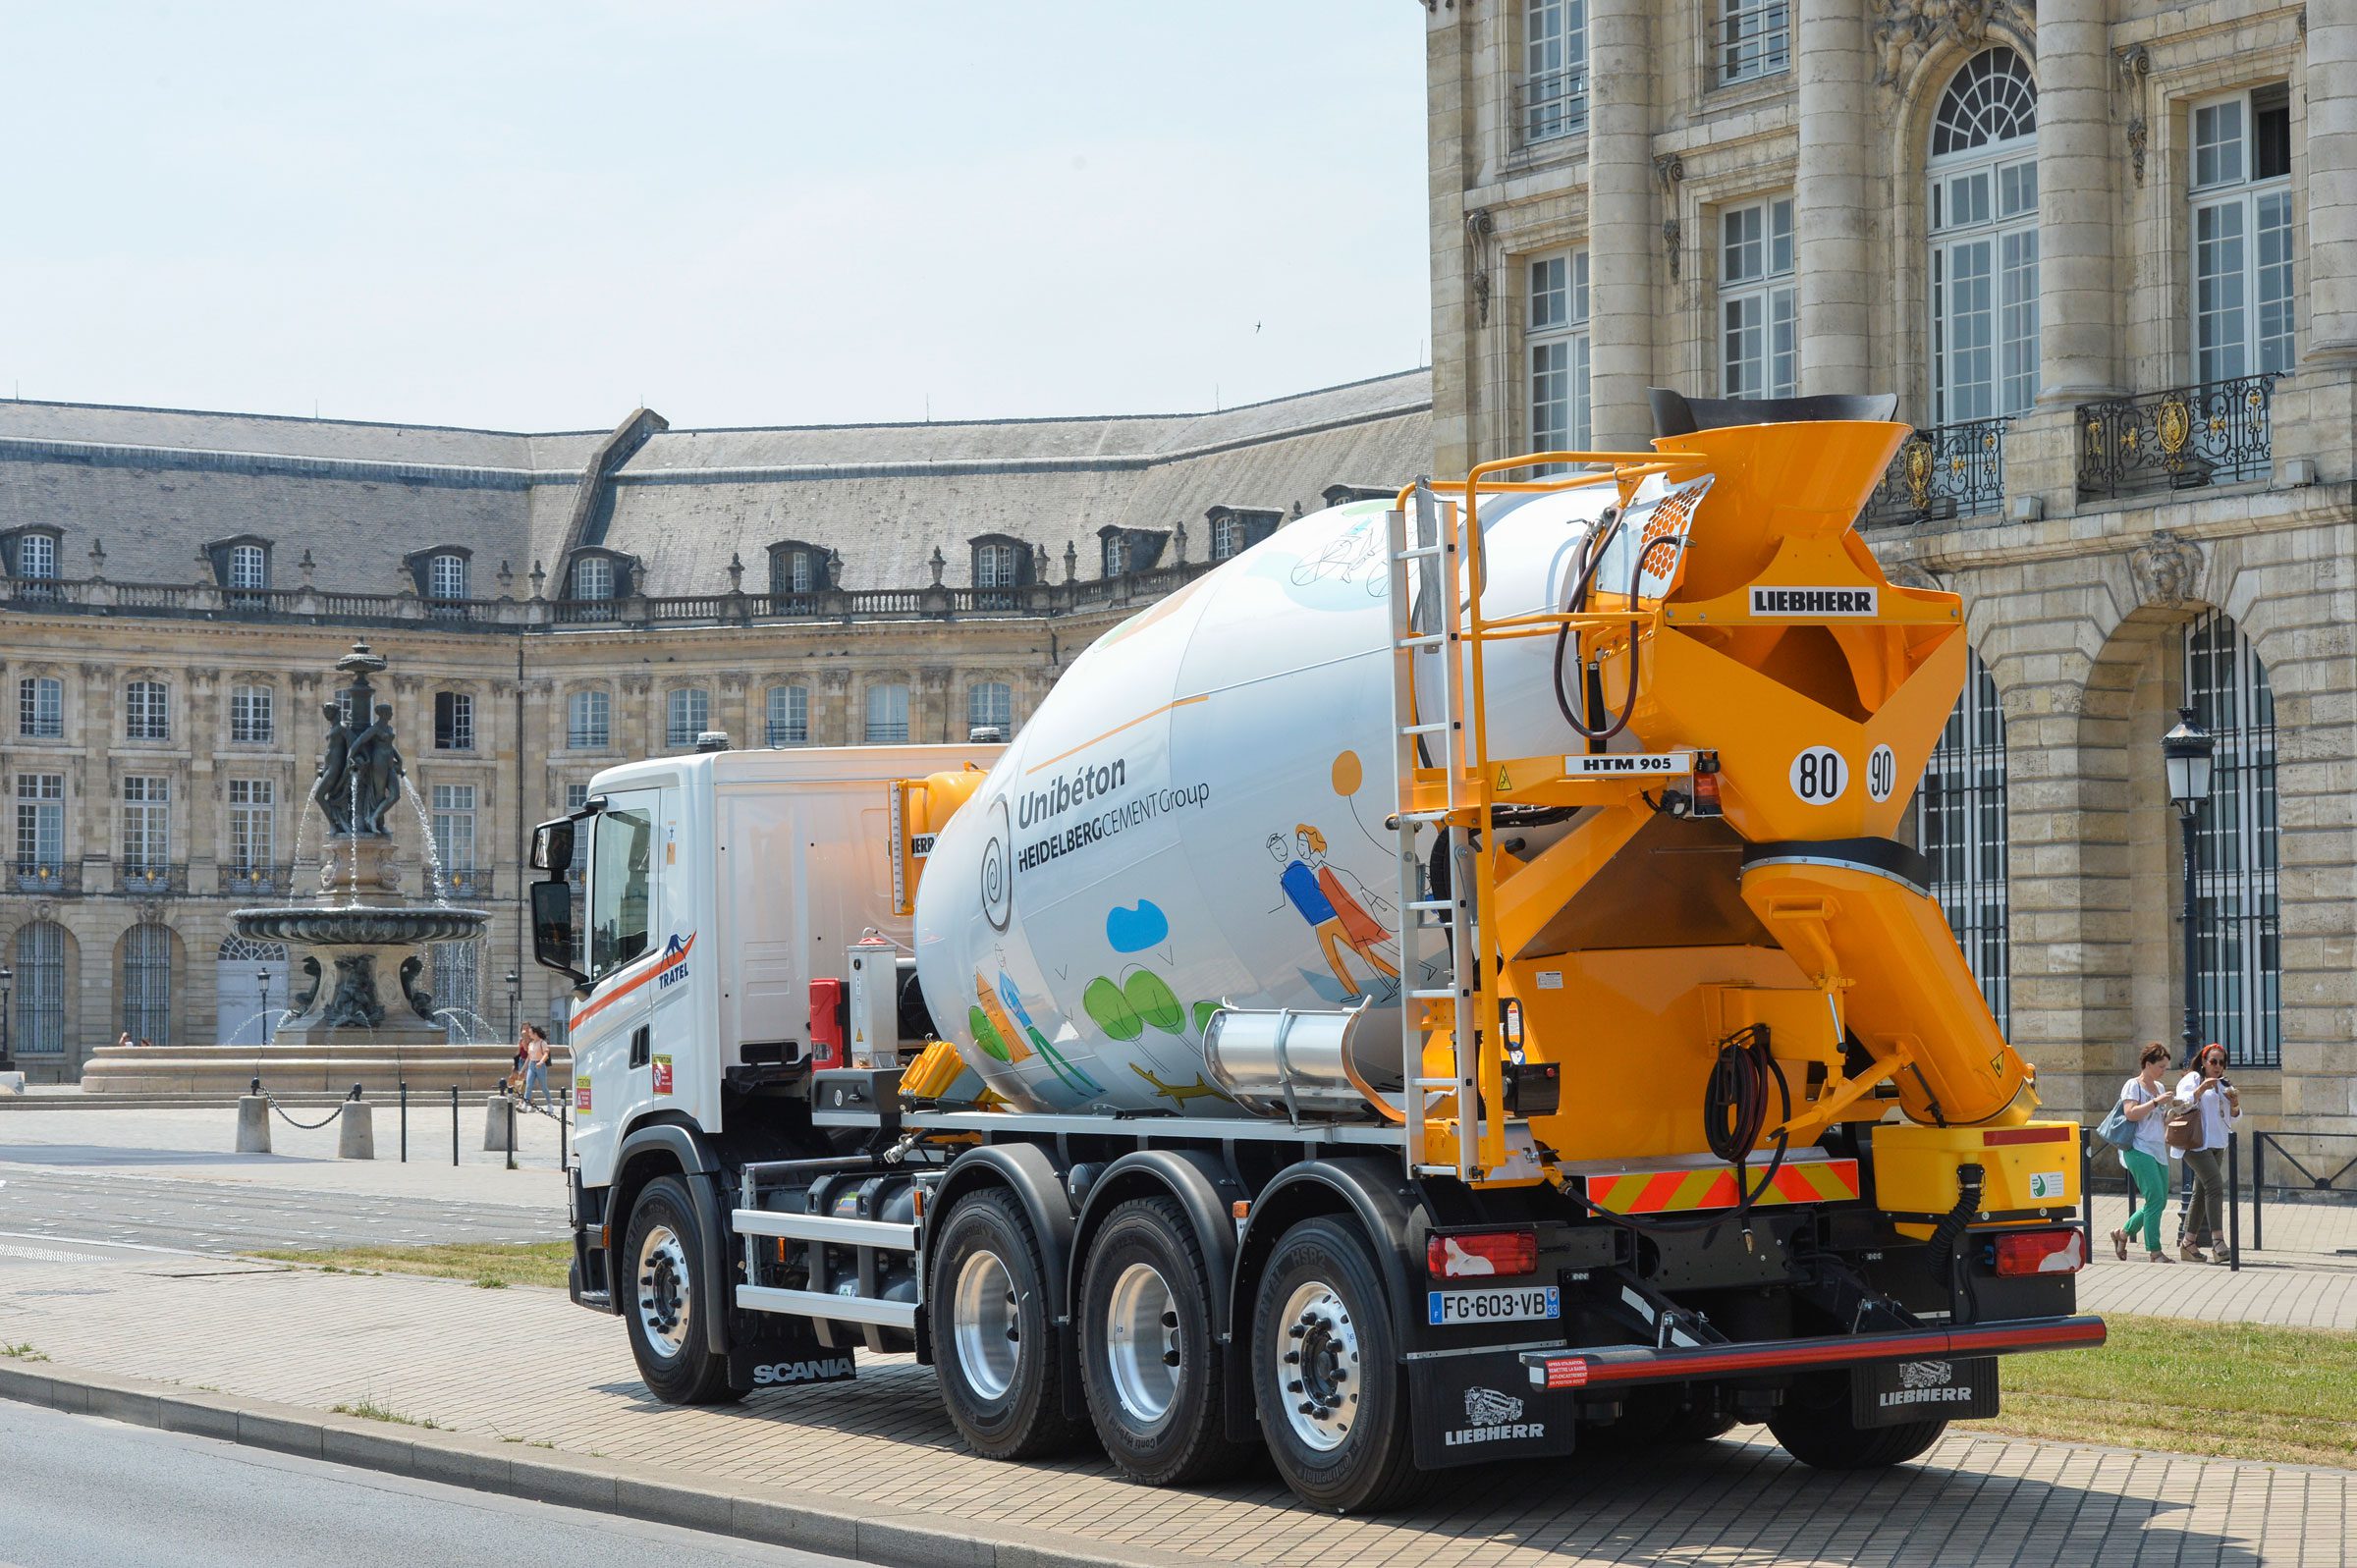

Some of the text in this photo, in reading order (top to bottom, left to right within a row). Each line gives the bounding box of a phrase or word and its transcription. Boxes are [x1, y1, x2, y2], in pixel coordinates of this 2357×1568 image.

[1754, 590, 1872, 612] LIEBHERR
[1583, 757, 1672, 771] HTM 905
[1800, 752, 1837, 798] 80
[1871, 750, 1891, 797] 90
[1018, 758, 1125, 830] Unibéton
[659, 962, 689, 990] TRATEL
[1290, 1246, 1326, 1269] HSR2
[1548, 1304, 1558, 1316] 33
[753, 1358, 854, 1383] SCANIA
[1880, 1386, 1972, 1407] LIEBHERR
[1133, 1436, 1156, 1450] Conti
[1445, 1423, 1545, 1446] LIEBHERR
[1303, 1451, 1352, 1485] Continental
